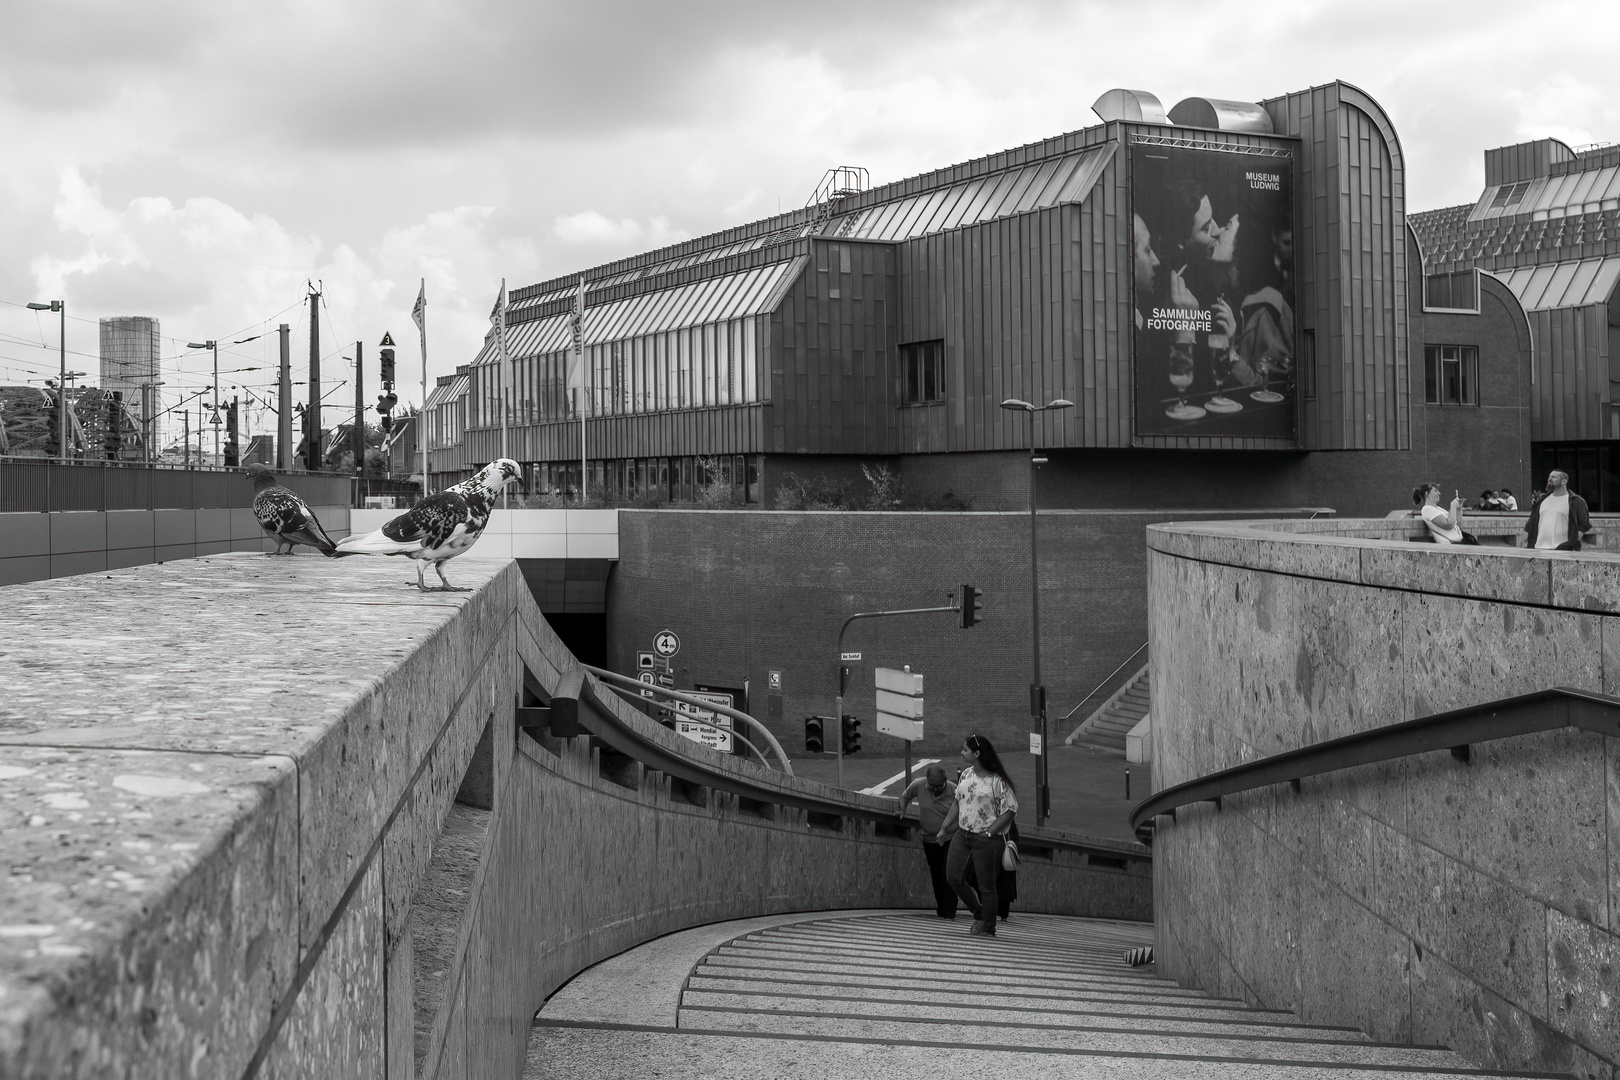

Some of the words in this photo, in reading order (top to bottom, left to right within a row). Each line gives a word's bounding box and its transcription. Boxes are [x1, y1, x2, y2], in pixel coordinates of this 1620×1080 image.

[1245, 172, 1280, 182] MUSEUM
[1250, 180, 1280, 191] LUDWIG
[1152, 307, 1212, 320] SAMMLUNG
[1147, 318, 1212, 332] FOTOGRAFIE
[385, 335, 390, 345] 3
